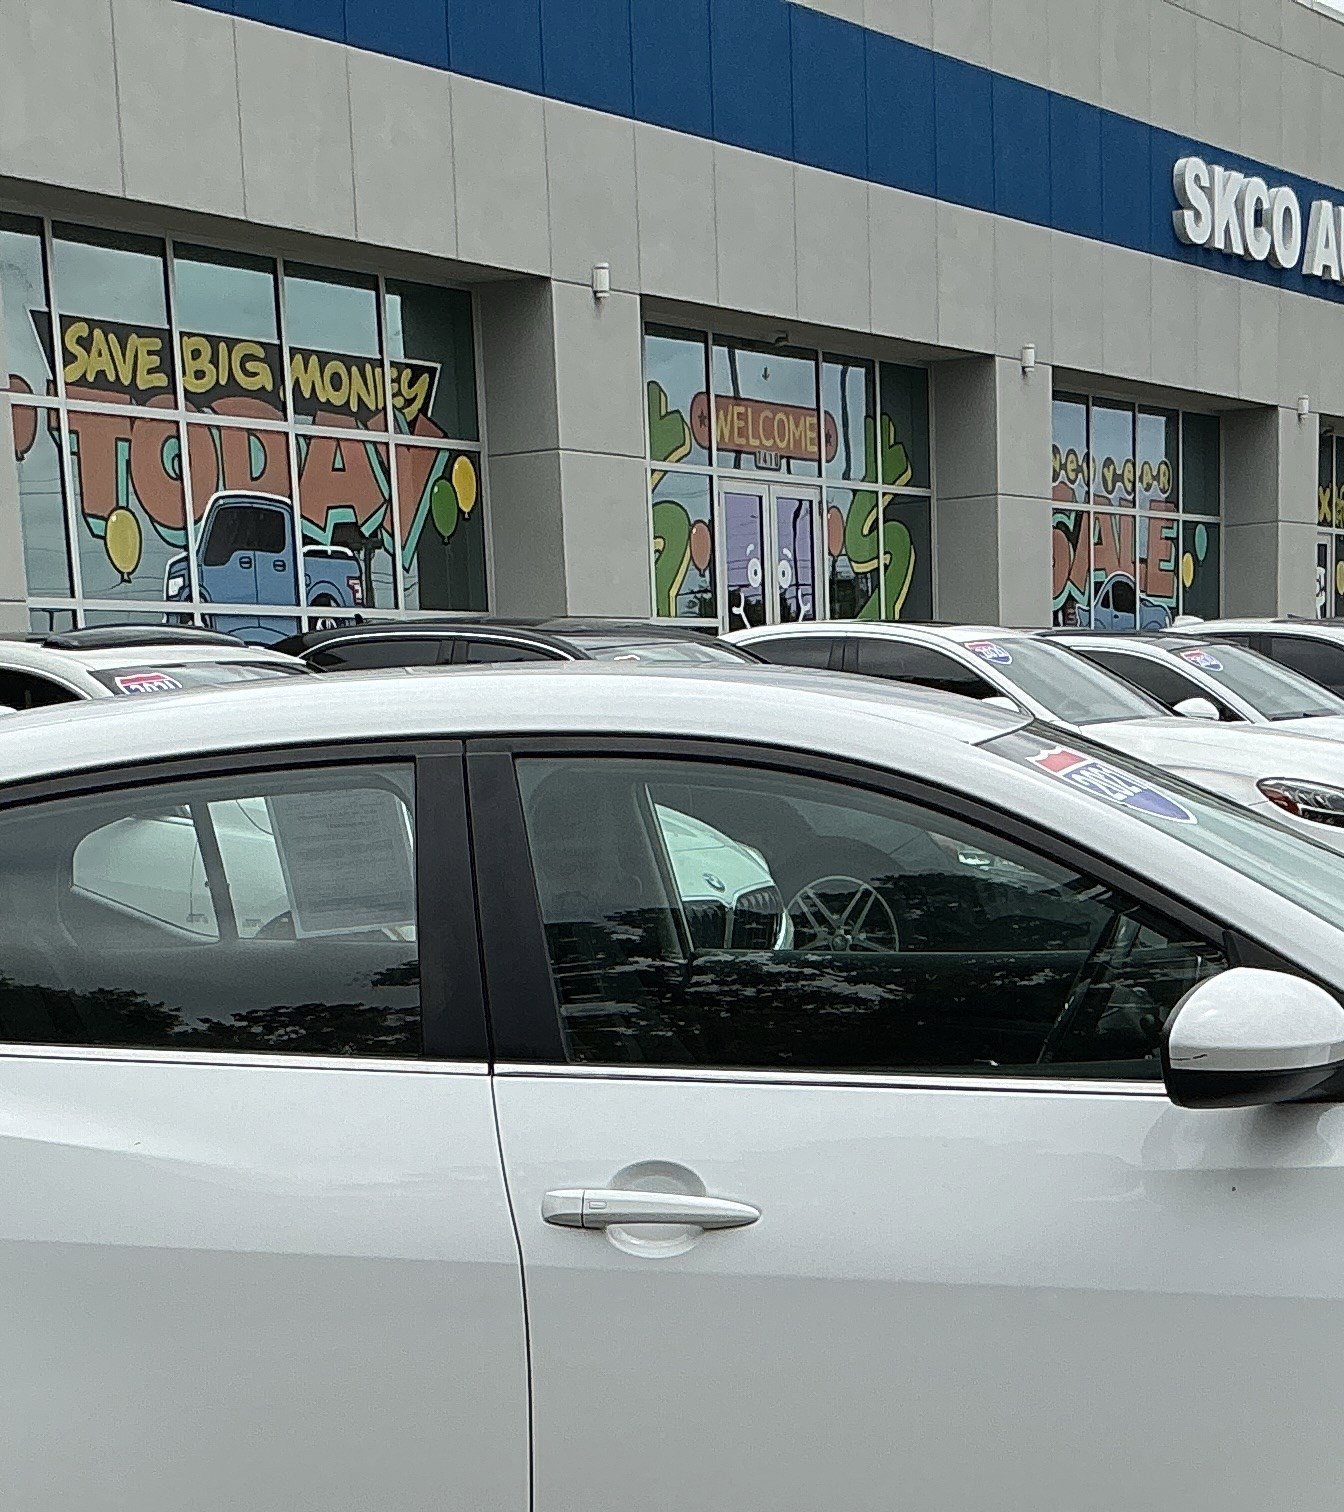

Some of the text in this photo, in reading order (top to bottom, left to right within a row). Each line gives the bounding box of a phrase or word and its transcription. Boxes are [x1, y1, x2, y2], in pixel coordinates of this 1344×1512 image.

[1172, 156, 1302, 269] SKCO
[63, 321, 430, 421] SAVE BIG MONEY
[49, 384, 446, 552] TODAY
[716, 404, 817, 452] WELCOME
